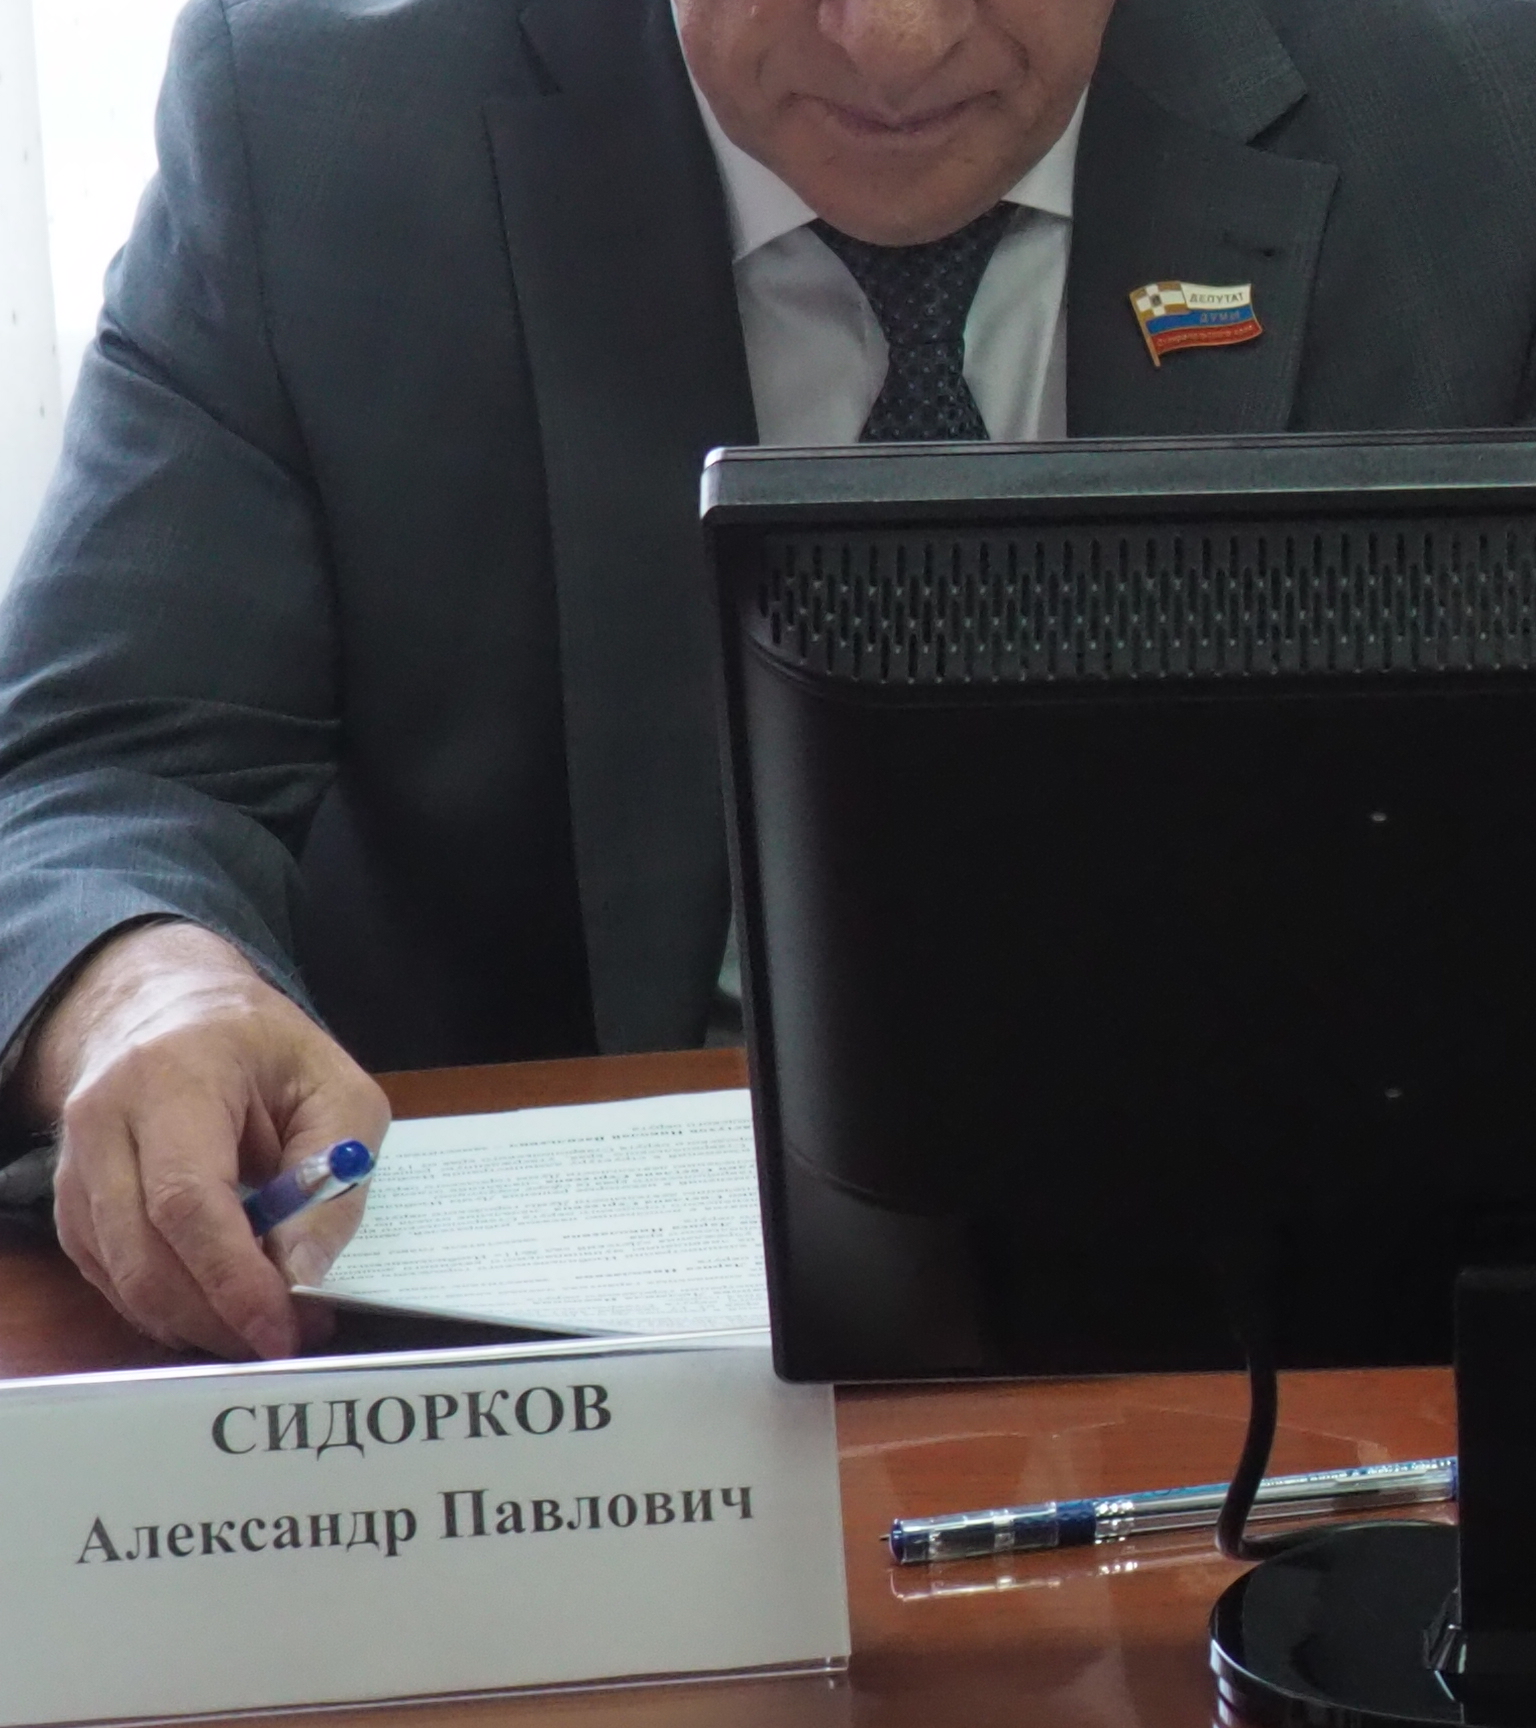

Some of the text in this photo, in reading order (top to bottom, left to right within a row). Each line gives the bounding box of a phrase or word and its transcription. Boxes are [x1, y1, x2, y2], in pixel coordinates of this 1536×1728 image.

[1188, 292, 1244, 304] ДЕПУТАТ
[211, 1384, 613, 1458] СИДОРКОВ
[76, 1484, 754, 1563] Александр Павлович
